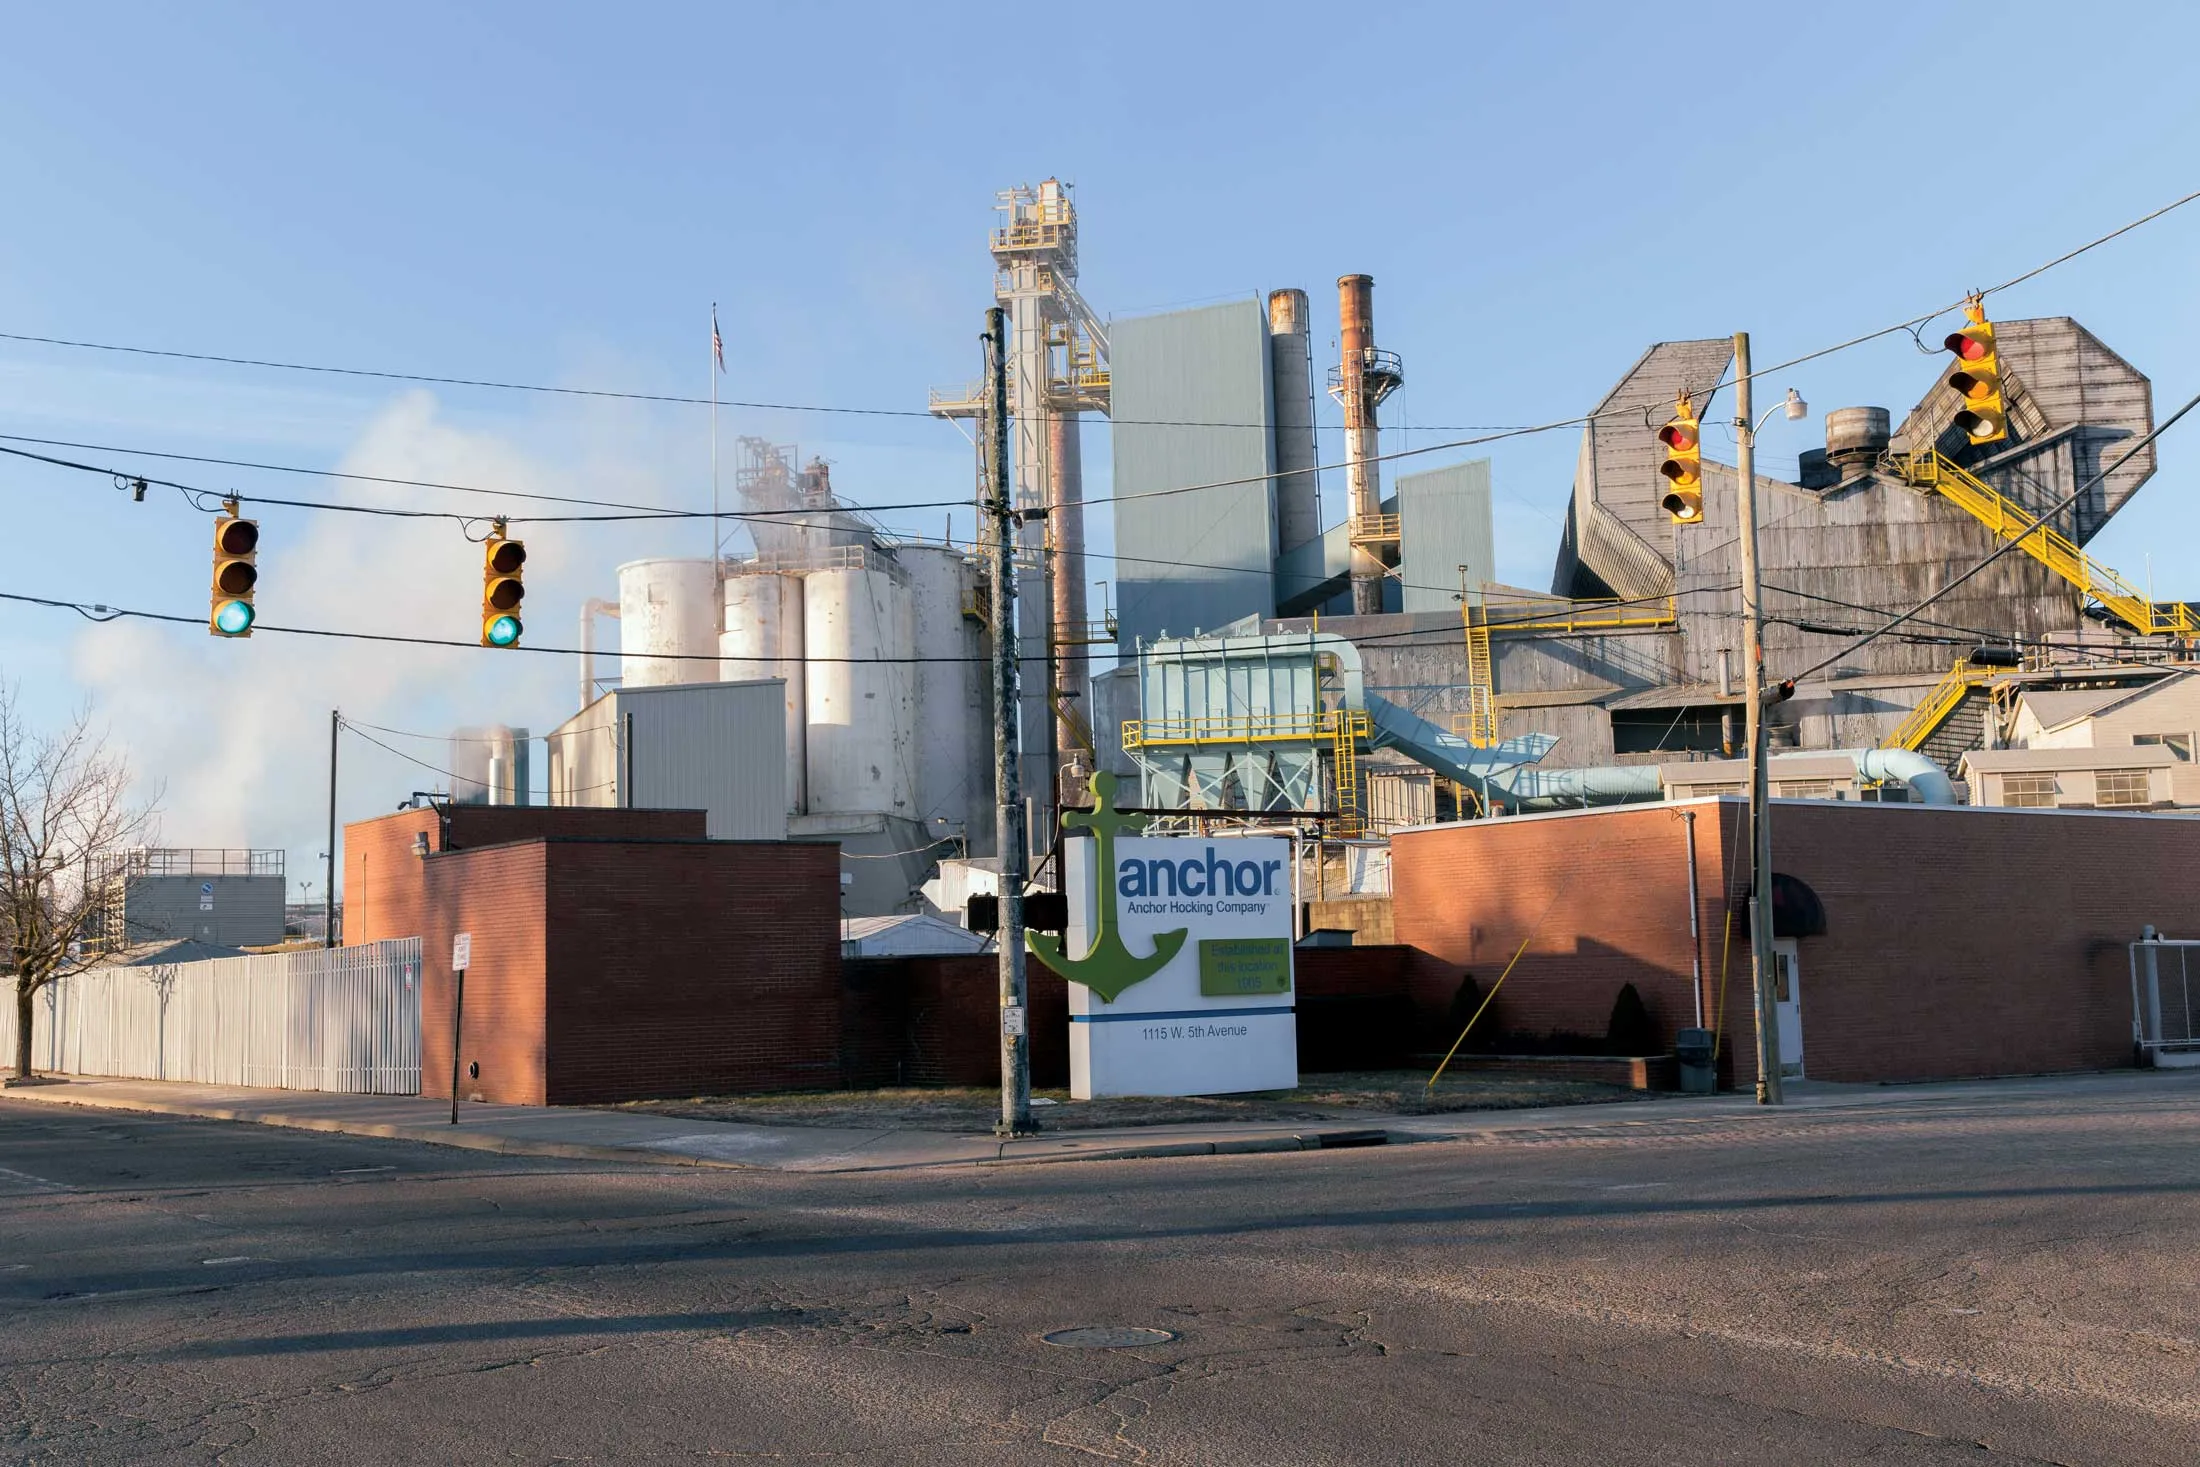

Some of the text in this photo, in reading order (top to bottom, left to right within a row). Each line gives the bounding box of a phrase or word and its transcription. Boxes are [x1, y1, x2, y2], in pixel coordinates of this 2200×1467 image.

[1118, 846, 1281, 898] anchor
[1127, 900, 1266, 916] Anchor Hocking Company
[1142, 1024, 1247, 1040] 1115 W. 5th Avenue
